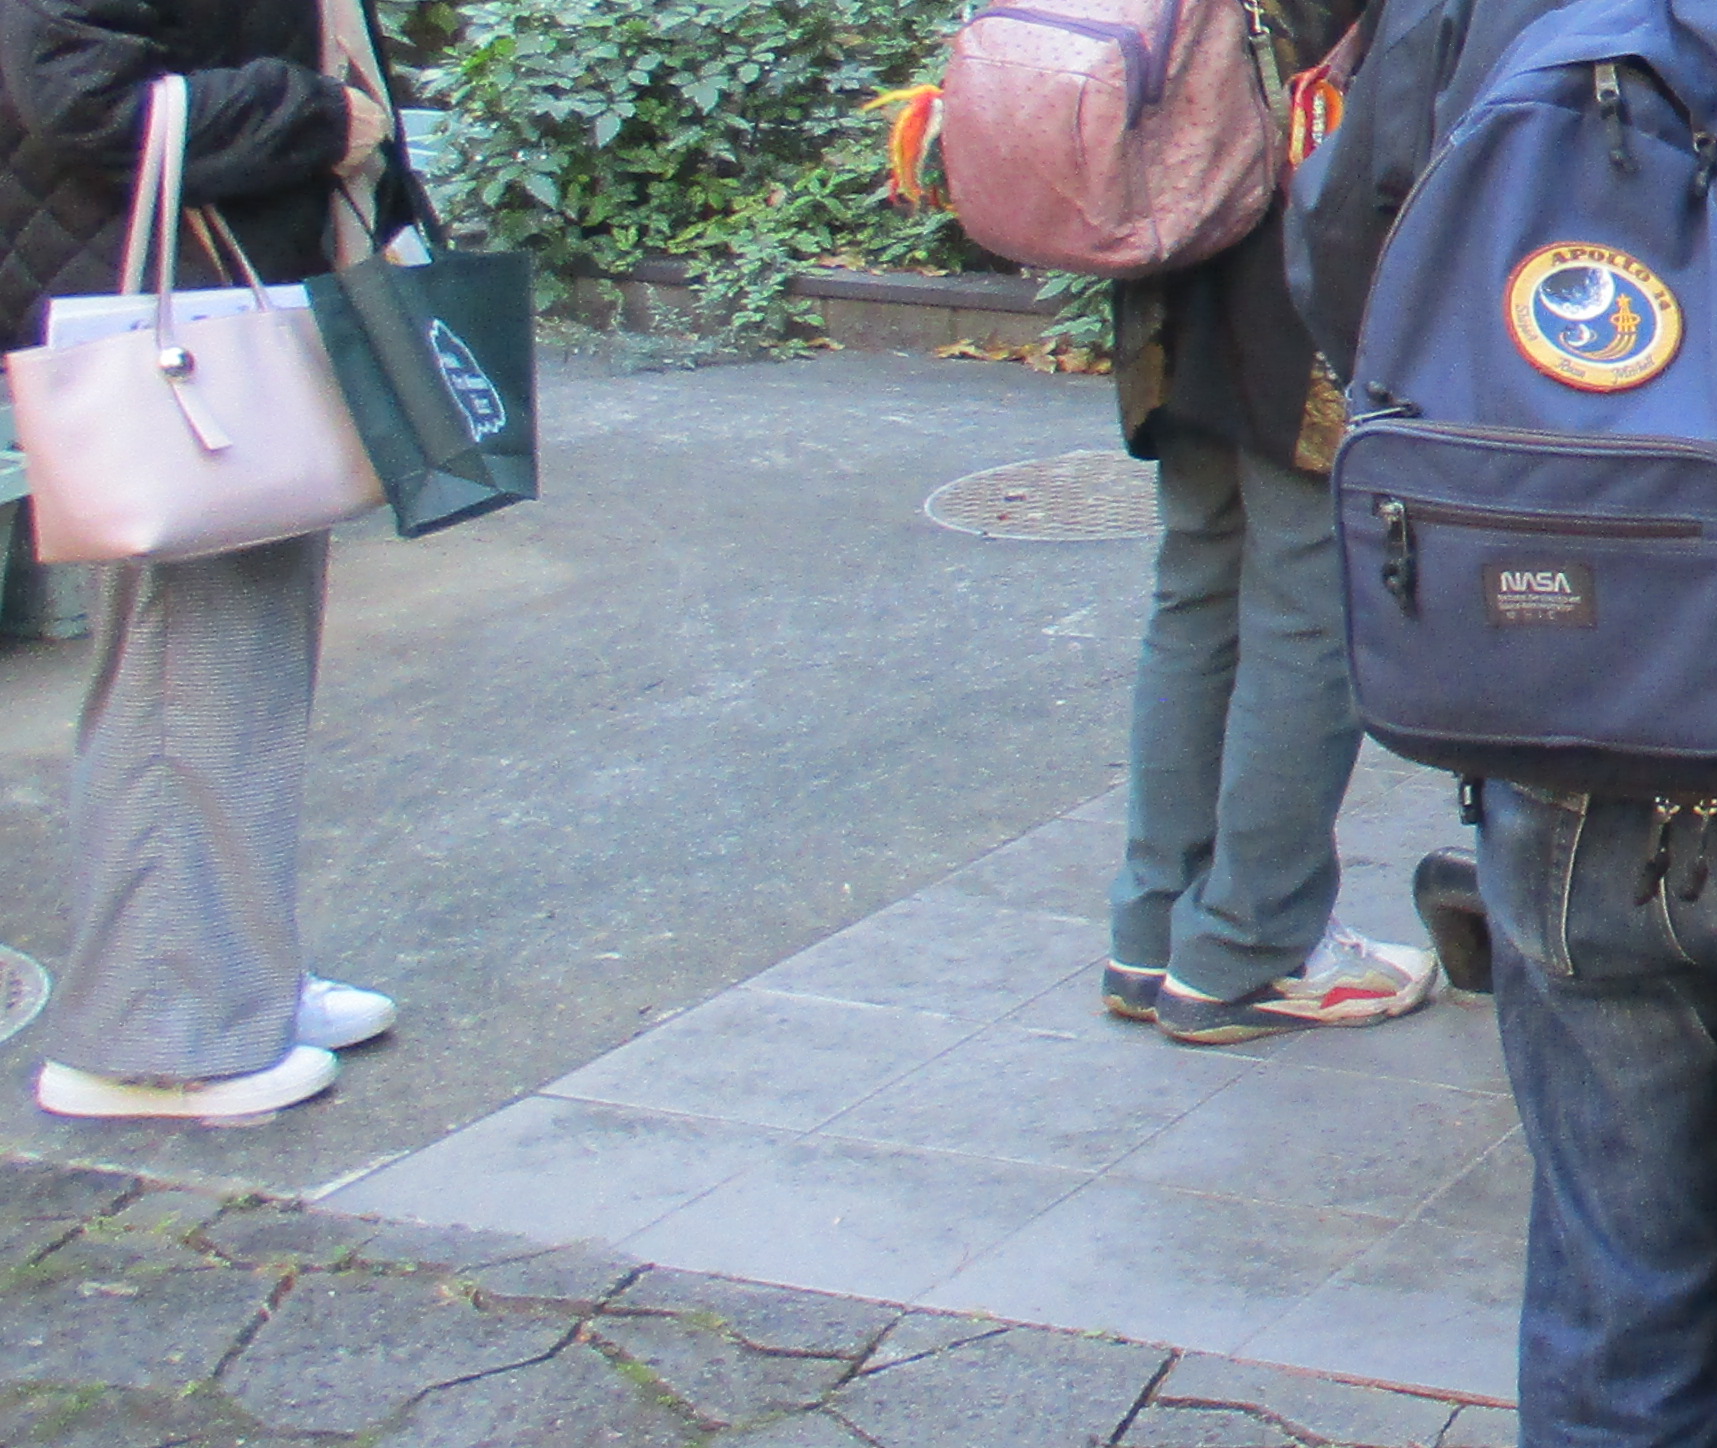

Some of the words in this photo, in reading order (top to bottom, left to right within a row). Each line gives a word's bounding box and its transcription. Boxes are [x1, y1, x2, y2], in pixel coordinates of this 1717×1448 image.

[1549, 248, 1652, 283] APOLLO
[1653, 290, 1673, 312] 14
[1500, 570, 1572, 594] NASA
